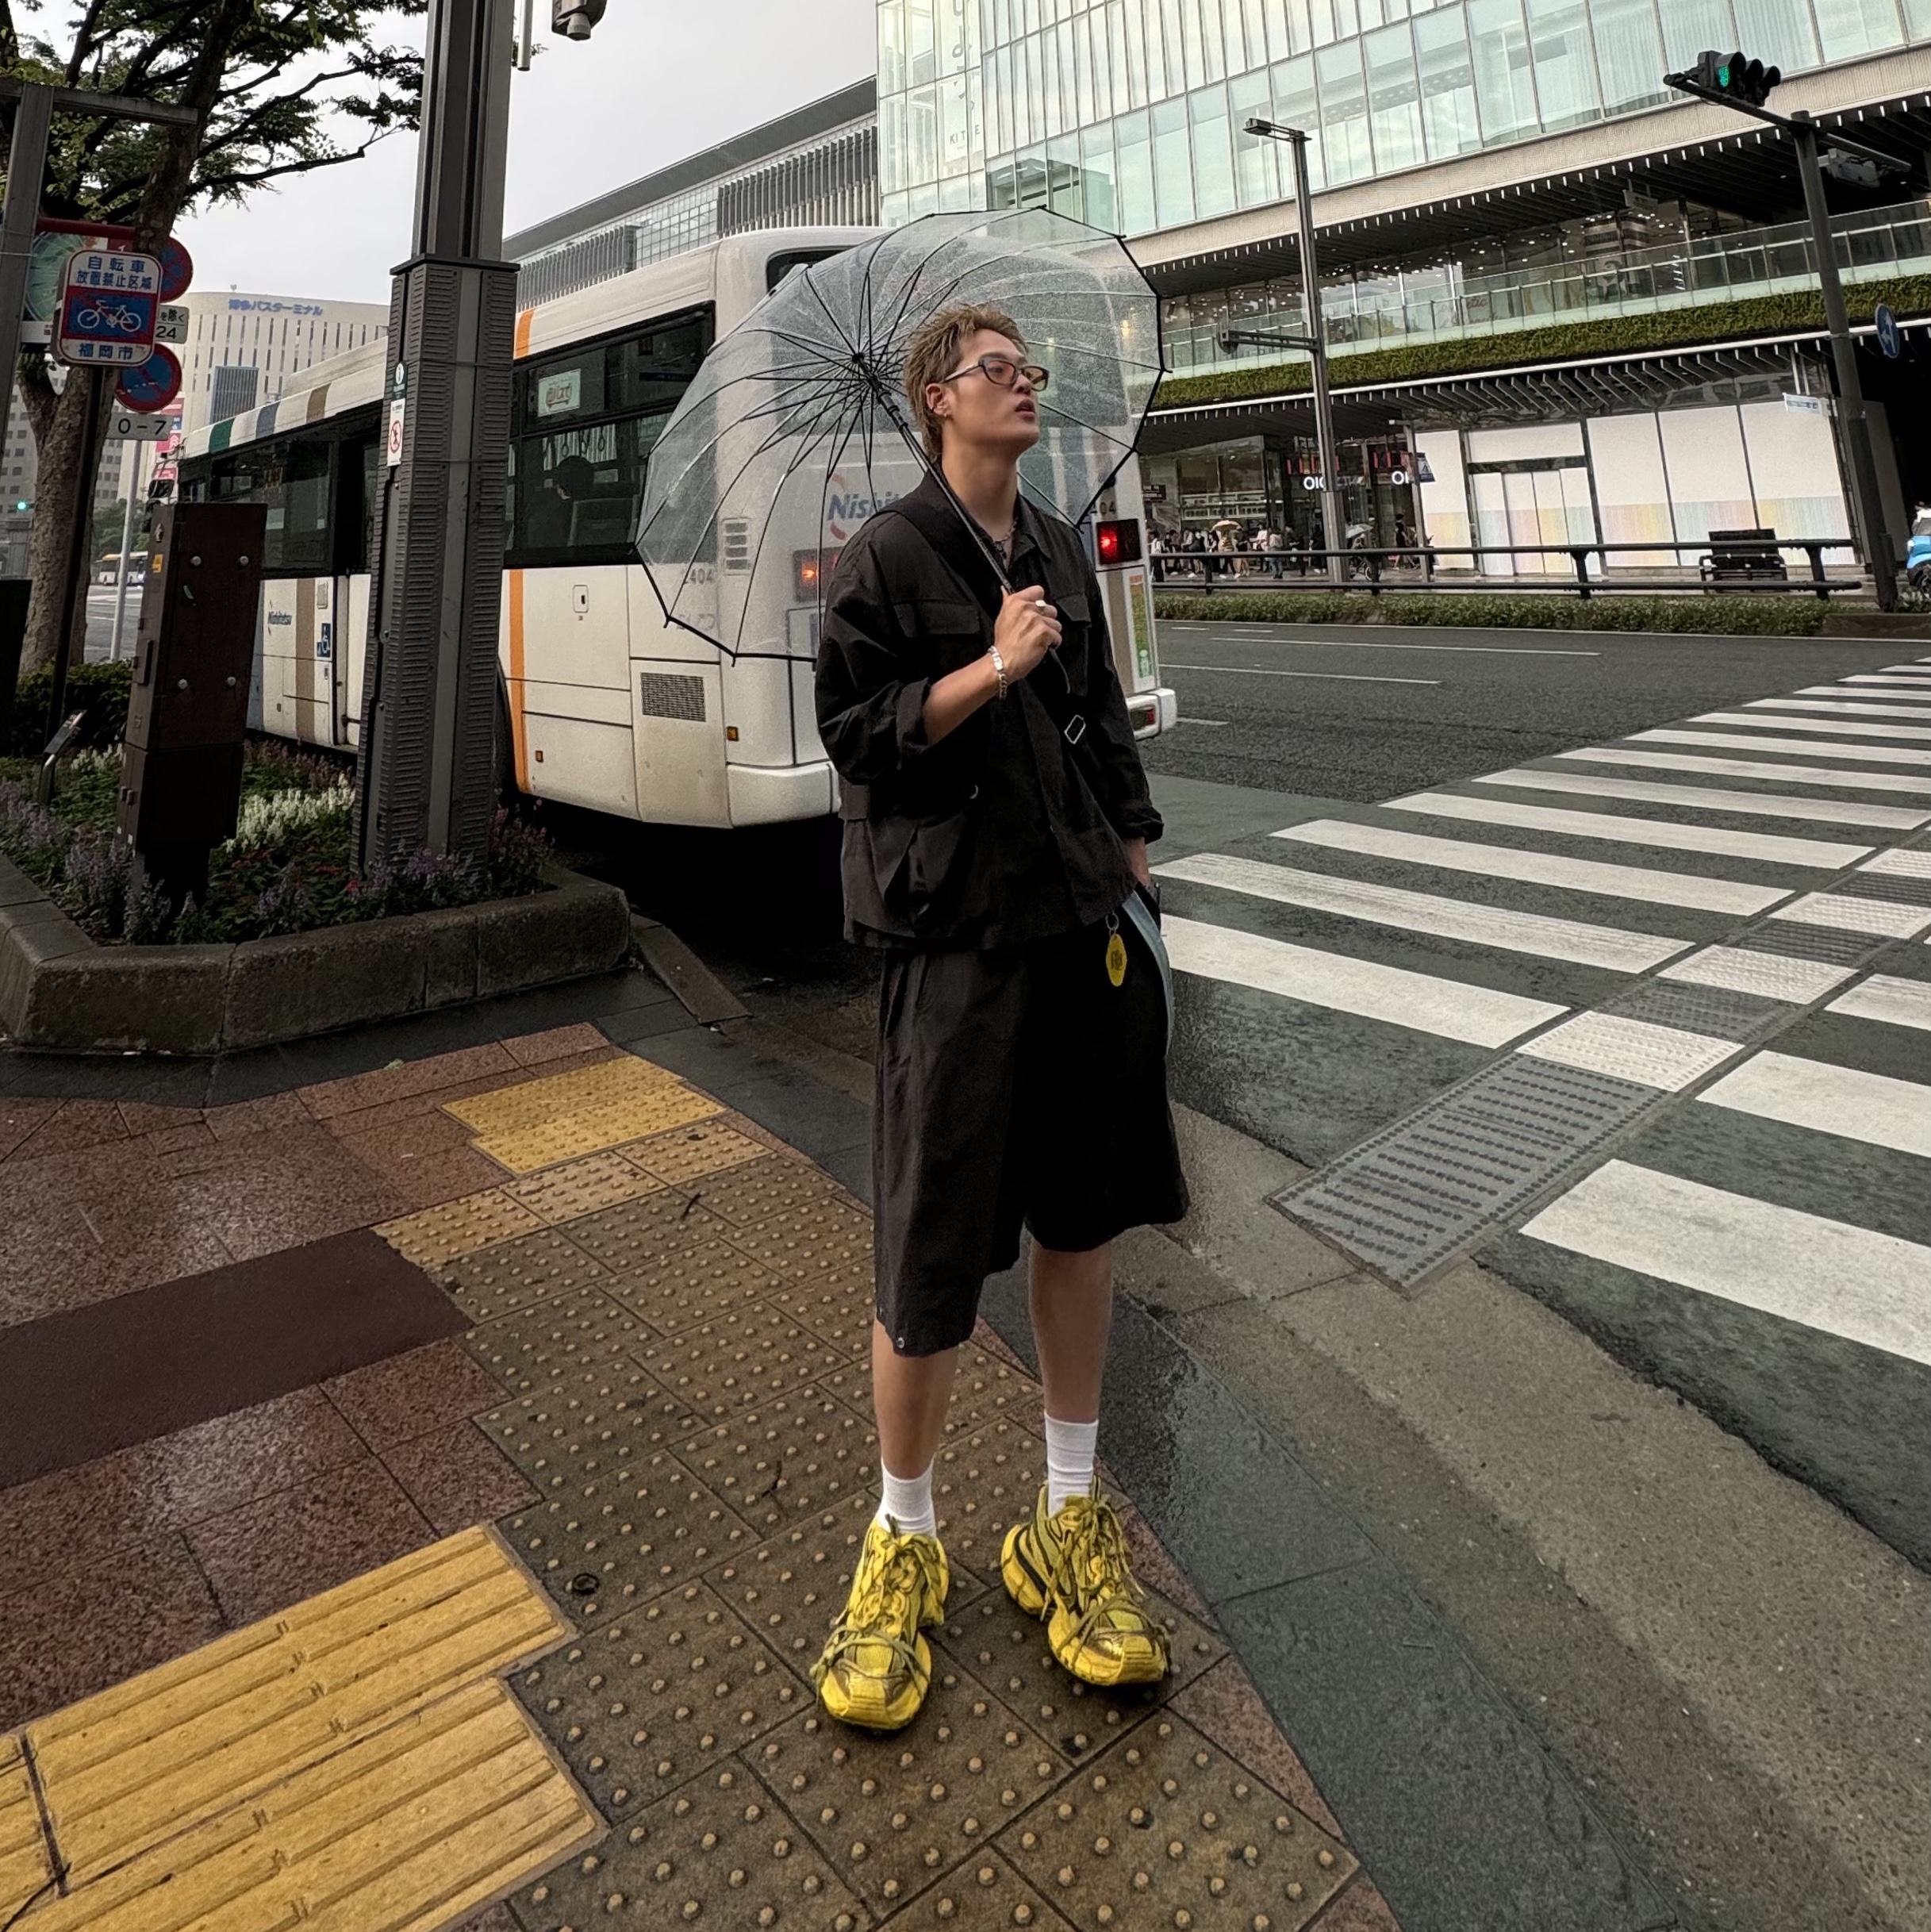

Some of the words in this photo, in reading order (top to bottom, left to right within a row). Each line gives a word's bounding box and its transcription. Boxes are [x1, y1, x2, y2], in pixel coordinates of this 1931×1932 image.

[87, 255, 146, 274] 自転車
[75, 269, 154, 290] 放置禁止区域
[155, 325, 177, 340] 24
[79, 342, 134, 360] 福岡市
